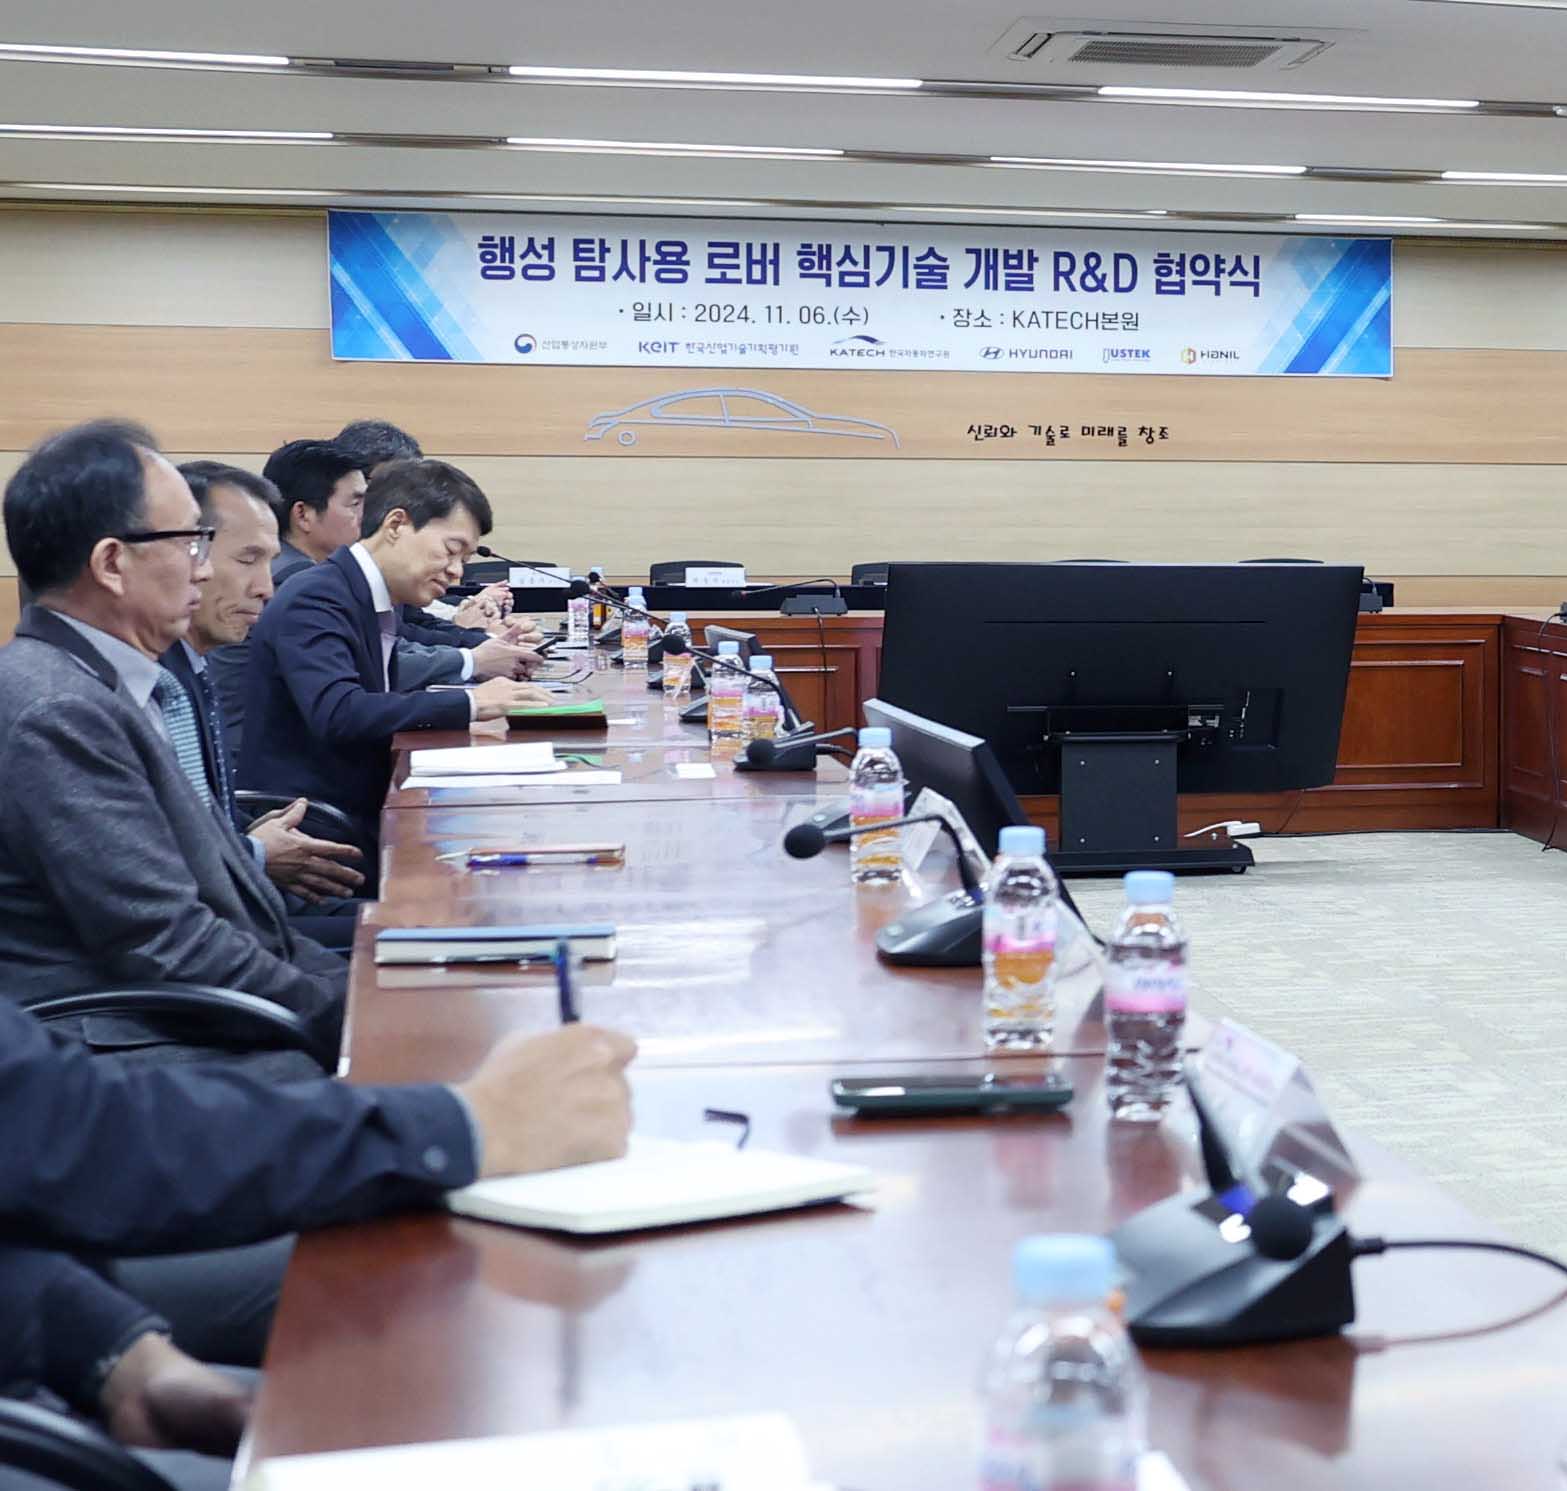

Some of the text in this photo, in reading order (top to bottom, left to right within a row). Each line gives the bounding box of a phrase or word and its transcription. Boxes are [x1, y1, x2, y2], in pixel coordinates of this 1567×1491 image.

[477, 235, 1261, 297] 행성 탐사용 로버 핵심기술 개발 R&D 협약식
[632, 302, 674, 323] 일시
[694, 303, 756, 324] 2024.
[765, 304, 791, 325] 11.
[799, 305, 870, 326] 06.(수)
[952, 308, 993, 329] 장소
[1012, 310, 1141, 331] KATECH본원
[829, 348, 886, 358] KATECH
[1009, 349, 1074, 360] HYUNDAI
[967, 424, 1170, 447] 신뢰와 기술로 미래를 창조
